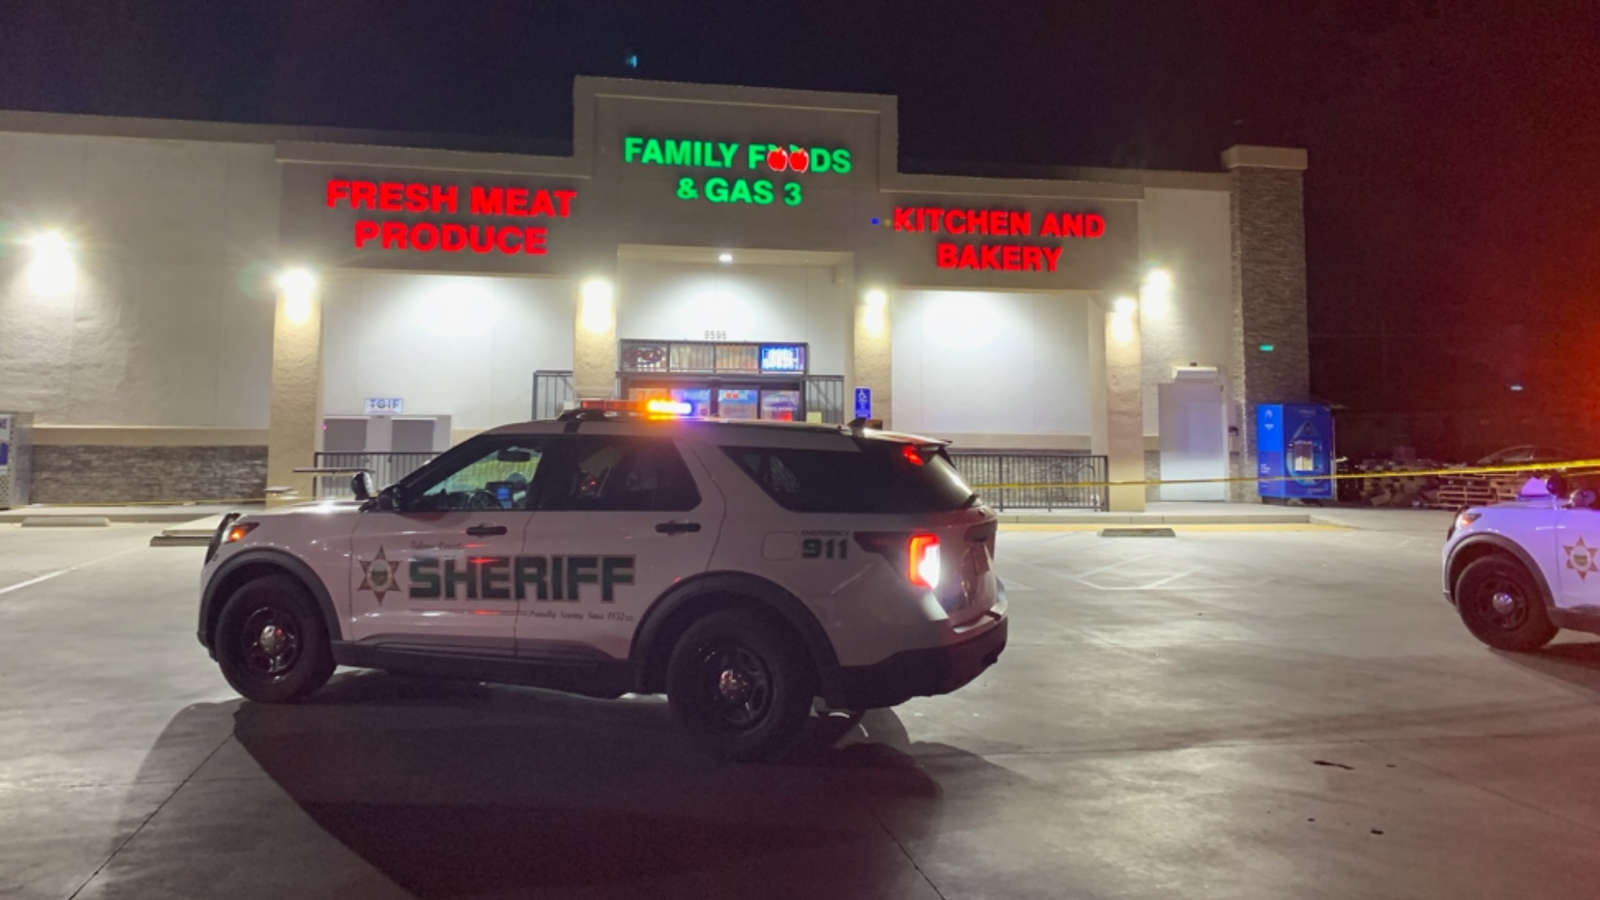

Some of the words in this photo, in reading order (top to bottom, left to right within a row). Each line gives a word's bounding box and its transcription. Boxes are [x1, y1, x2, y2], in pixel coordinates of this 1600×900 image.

[625, 137, 739, 168] FAMILY
[326, 179, 458, 214] FRESH
[470, 186, 577, 218] MEAT
[676, 177, 699, 200] &
[704, 177, 774, 205] GAS
[784, 182, 802, 206] 3
[354, 220, 548, 256] PRODUCE
[893, 207, 1031, 236] KITCHEN
[1040, 212, 1106, 239] AND
[937, 242, 1063, 273] BAKERY
[801, 538, 849, 560] 911
[409, 554, 636, 603] SHERIFF
